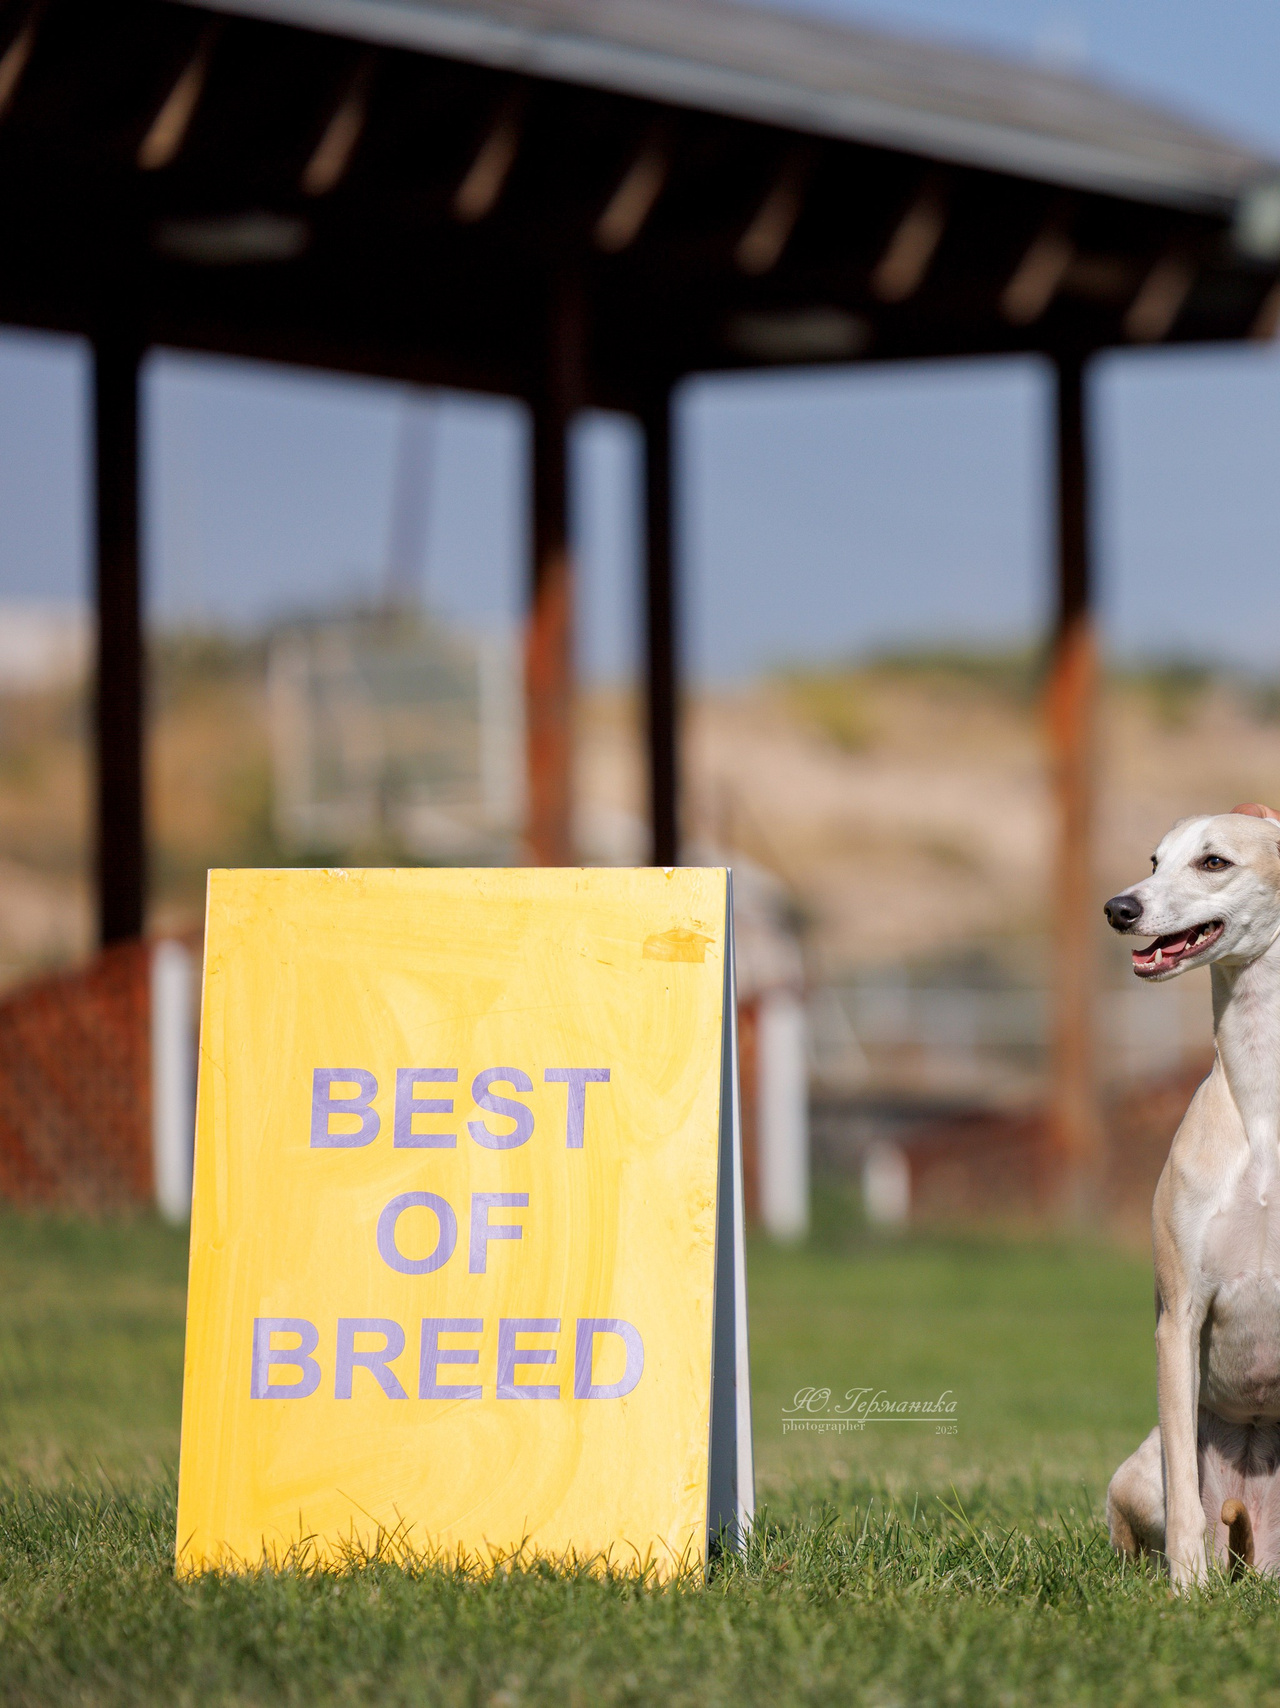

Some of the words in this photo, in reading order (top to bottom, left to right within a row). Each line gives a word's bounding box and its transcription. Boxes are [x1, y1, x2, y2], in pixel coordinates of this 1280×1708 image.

[309, 1066, 611, 1150] BEST
[376, 1191, 530, 1275] OF
[249, 1317, 645, 1400] BREED
